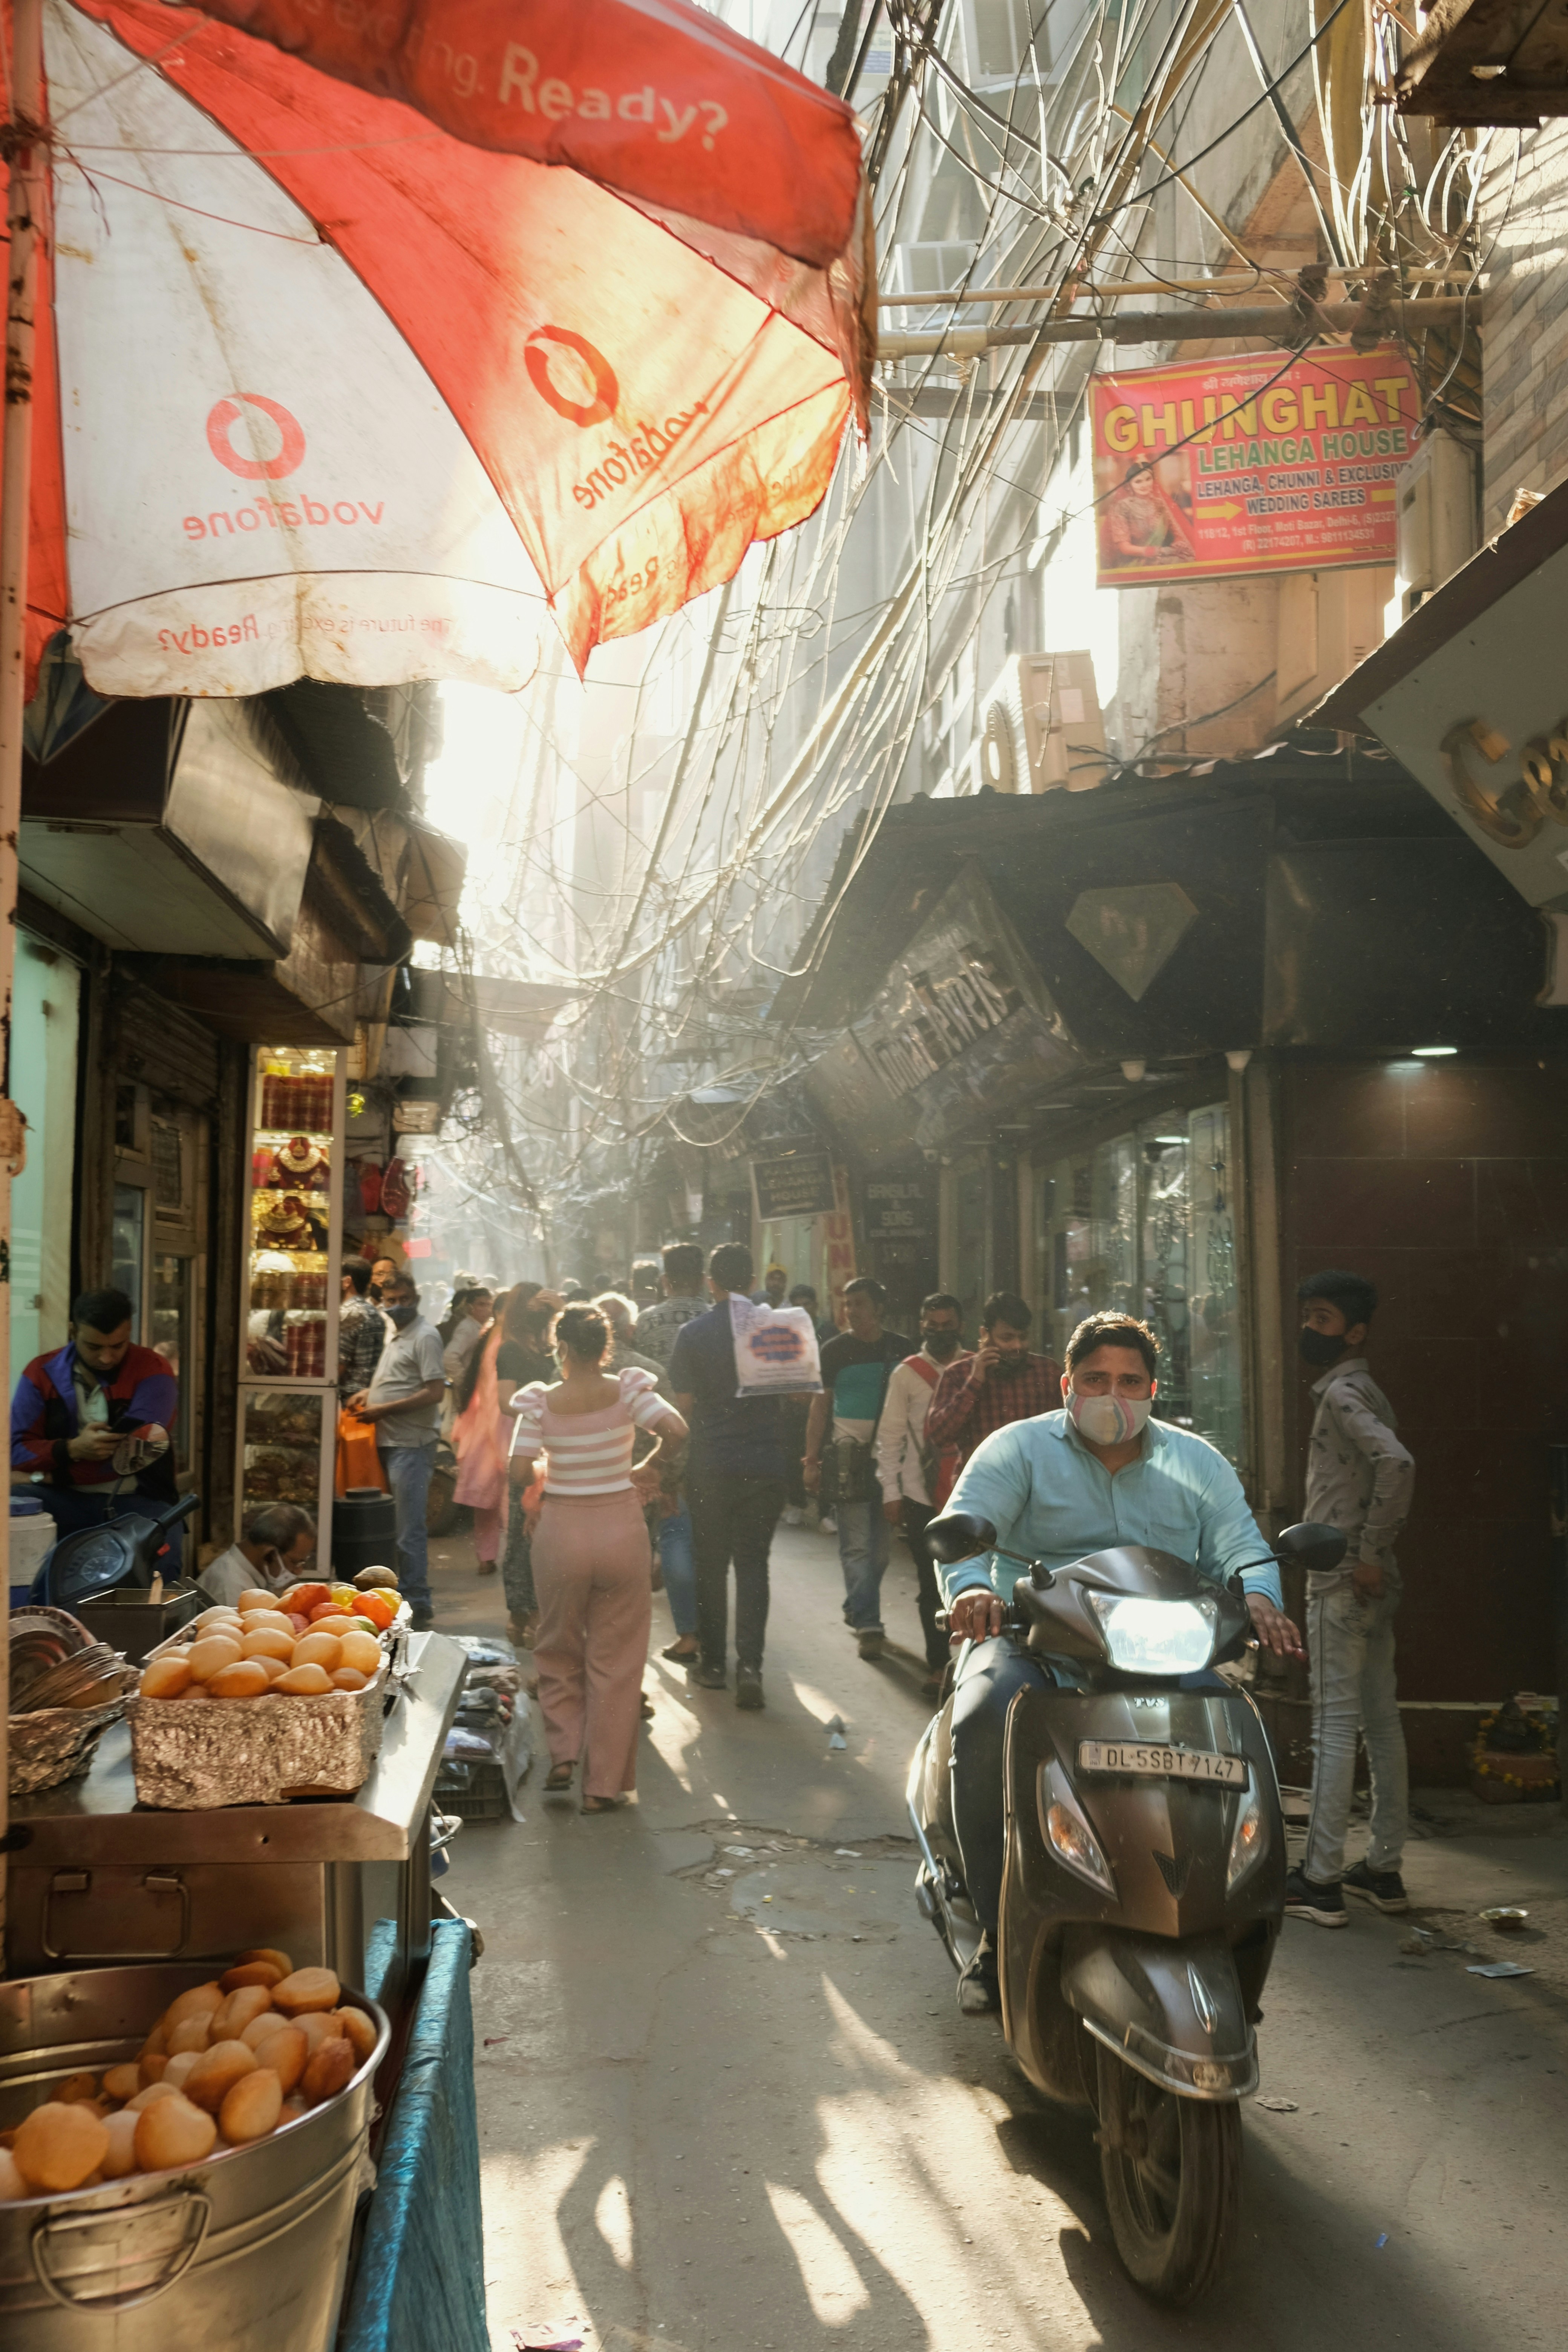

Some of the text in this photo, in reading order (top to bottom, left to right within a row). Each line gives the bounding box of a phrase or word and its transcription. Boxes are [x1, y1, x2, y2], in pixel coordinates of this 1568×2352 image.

[498, 40, 729, 151] Ready?
[1103, 377, 1409, 453] GHUNGHAT
[1199, 428, 1409, 474] LEHANGA HOUSE
[1268, 470, 1320, 490] CHUNNI
[1325, 469, 1335, 485] &
[1339, 461, 1409, 484] EXCLUSIV
[1246, 487, 1367, 516] WEDDING SAREES
[1134, 1697, 1165, 1708] TVS
[1107, 1748, 1131, 1768] DL
[1136, 1750, 1184, 1772] 5SBT
